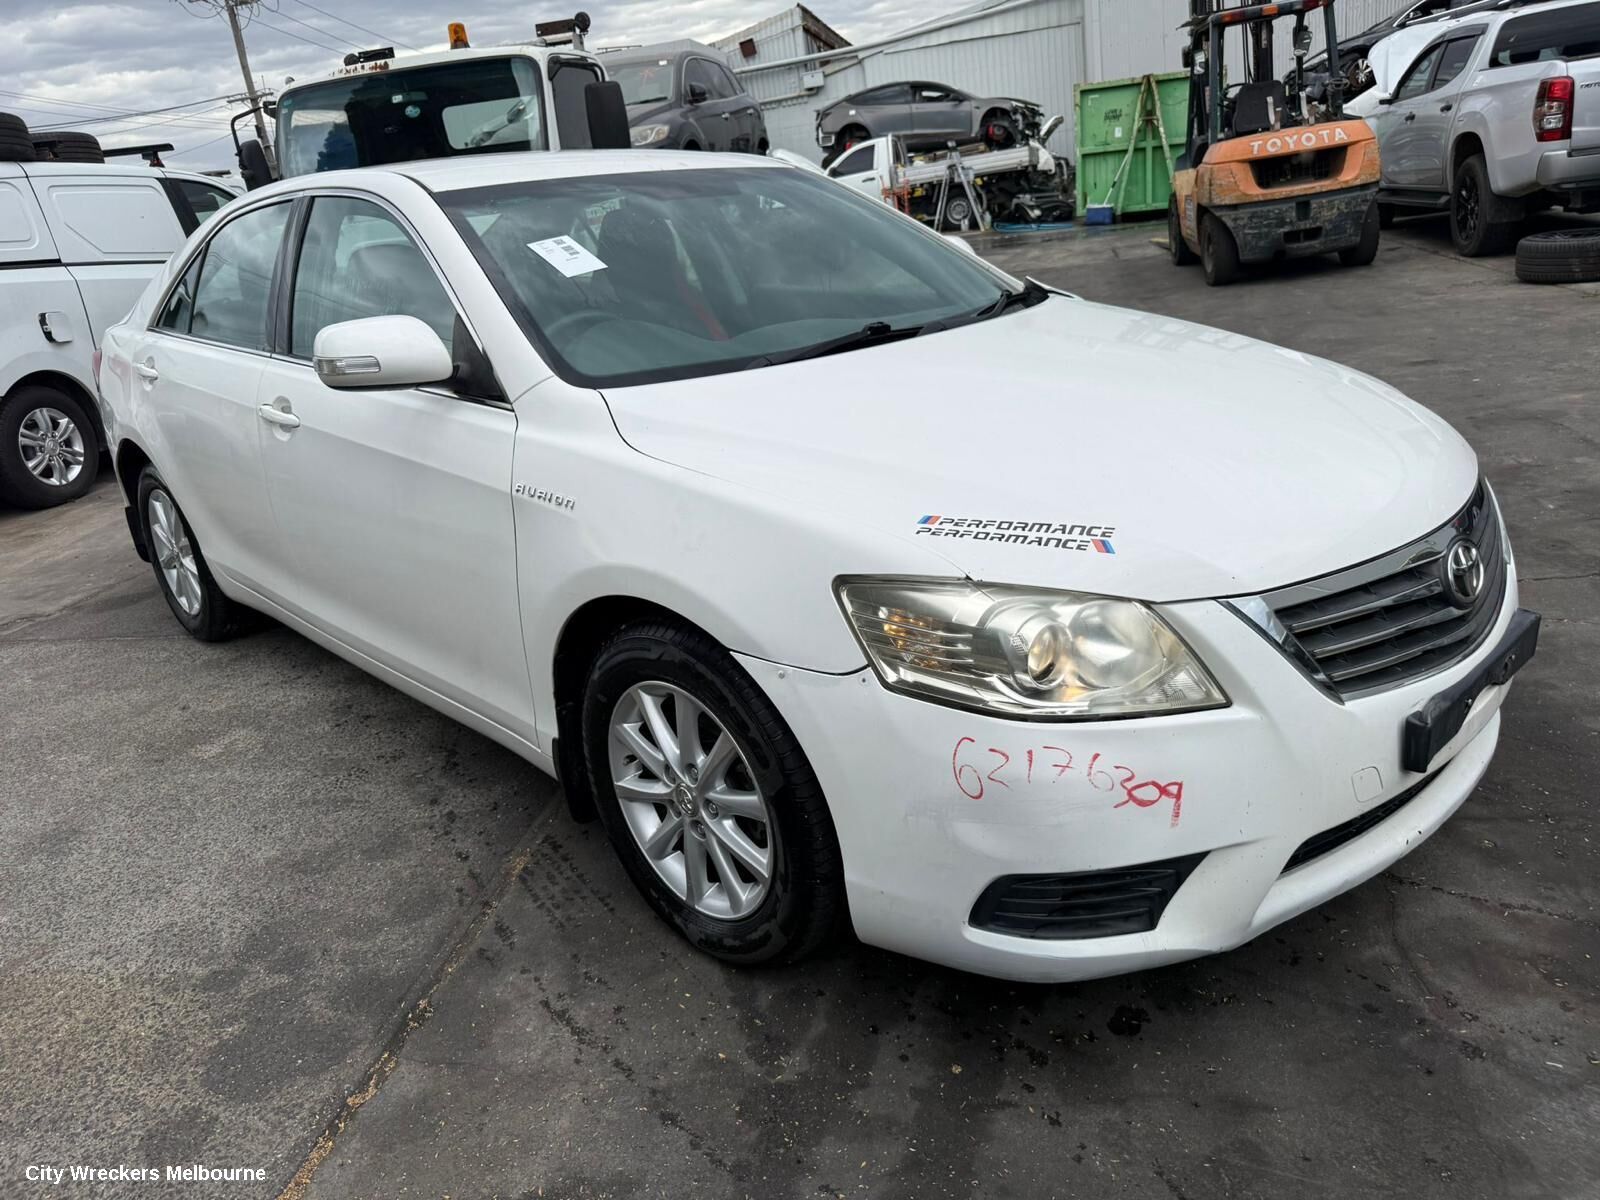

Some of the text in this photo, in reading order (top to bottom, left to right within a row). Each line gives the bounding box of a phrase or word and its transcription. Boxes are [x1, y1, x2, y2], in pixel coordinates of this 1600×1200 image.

[1250, 127, 1348, 155] TOYOTA
[515, 482, 576, 511] AURION
[915, 527, 1091, 551] PERFORMANCE
[938, 517, 1116, 538] PERFORMANCE
